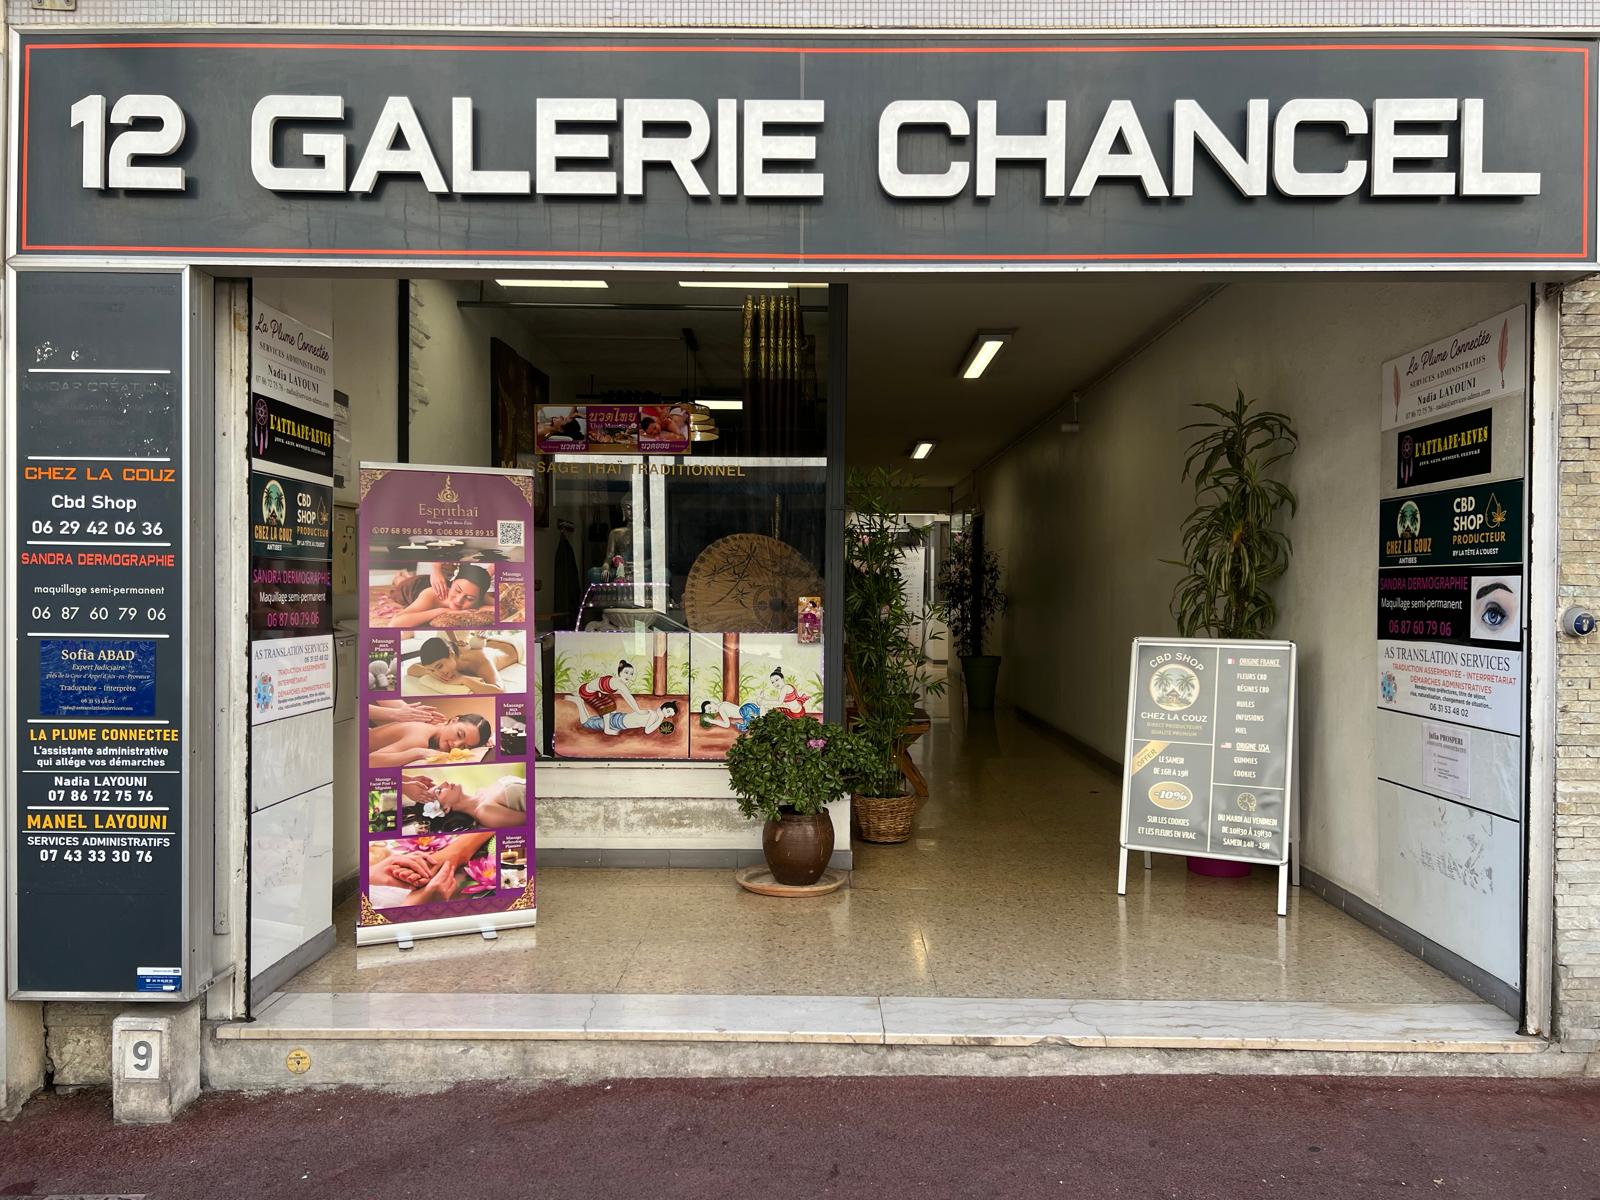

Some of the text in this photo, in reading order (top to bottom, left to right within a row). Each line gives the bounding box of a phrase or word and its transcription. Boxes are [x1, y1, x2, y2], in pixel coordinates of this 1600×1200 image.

[70, 93, 1541, 198] 12 GALERIE CHANCEL
[270, 319, 296, 346] Plume
[297, 332, 330, 361] Connectée
[1406, 330, 1492, 376] La Plume Connectée
[268, 364, 287, 381] Nadia
[288, 372, 319, 394] LAYOUNI
[1410, 354, 1486, 389] SERVICES ADMINISTRATIFS
[1417, 390, 1437, 406] Nadia
[1439, 377, 1477, 399] LAYOUNI
[589, 408, 637, 422] นวดไทย
[24, 467, 176, 482] CHEZ LA COUZ
[632, 463, 746, 477] TRADITIONNEL
[51, 494, 137, 512] Cbd Shop
[297, 492, 312, 507] CBD
[297, 510, 317, 524] SHOP
[418, 503, 479, 518] Esprithaï
[1454, 496, 1484, 531] CBD SHOP
[32, 520, 164, 536] 06 29 42 06 36
[254, 524, 269, 540] CHEZ
[270, 526, 278, 540] LA
[296, 527, 328, 538] PRODUCTEUR
[1452, 532, 1506, 545] PRODUCTEUR
[1386, 538, 1432, 555] CHEZ LA COUZ
[21, 553, 175, 567] SANDRA DERMOGRAPHIE
[253, 568, 330, 584] SANDRA DERMOGRAPHIE
[1380, 576, 1468, 590] SANDRA DERMOGRAPHIE
[34, 584, 164, 597] maquillage semi-permanent
[260, 592, 326, 605] Maquillage semi-permanent
[1381, 598, 1462, 612] Maquillage semi-permanent
[32, 606, 166, 621] 06 87 60 79 06
[267, 612, 320, 627] 06 87 60 79 06
[1389, 620, 1451, 636] 06 87 60 79 06
[61, 649, 136, 661] Sofia ABAD
[254, 650, 263, 660] AS
[264, 645, 304, 660] TRANSLATION
[304, 643, 329, 654] SERVICES
[1149, 652, 1205, 672] CBD SHOP
[1384, 647, 1510, 672] AS TRANSLATION SERVICES
[72, 664, 94, 672] Expert
[1393, 663, 1517, 686] TRADUCTION ASSERMENTÉE INTERPRÉTARIAT
[103, 684, 136, 693] Interprète
[1410, 675, 1492, 694] DÉMARCHES ADMINISTRATIVES
[1141, 712, 1166, 720] CHEZ
[1182, 714, 1208, 722] COUZ
[1430, 703, 1437, 712] 06
[1444, 706, 1452, 714] 53
[1452, 707, 1460, 716] 48
[1460, 708, 1468, 717] 02
[30, 728, 179, 742] LA PLUME CONNECTEE
[34, 746, 168, 756] L'assistante administrative
[37, 757, 54, 768] qui
[55, 756, 86, 768] allége
[109, 756, 166, 767] démarches
[54, 776, 148, 787] Nadia LAYOUNI
[48, 790, 154, 802] 07 86 72 75 76
[1154, 790, 1188, 800] -10%
[27, 814, 168, 830] MANEL LAYOUNI
[27, 836, 170, 848] SERVICES ADMINISTRATIFS
[1181, 831, 1196, 840] VRAC
[40, 849, 152, 862] 07 43 33 30 76
[132, 1040, 153, 1071] 9
